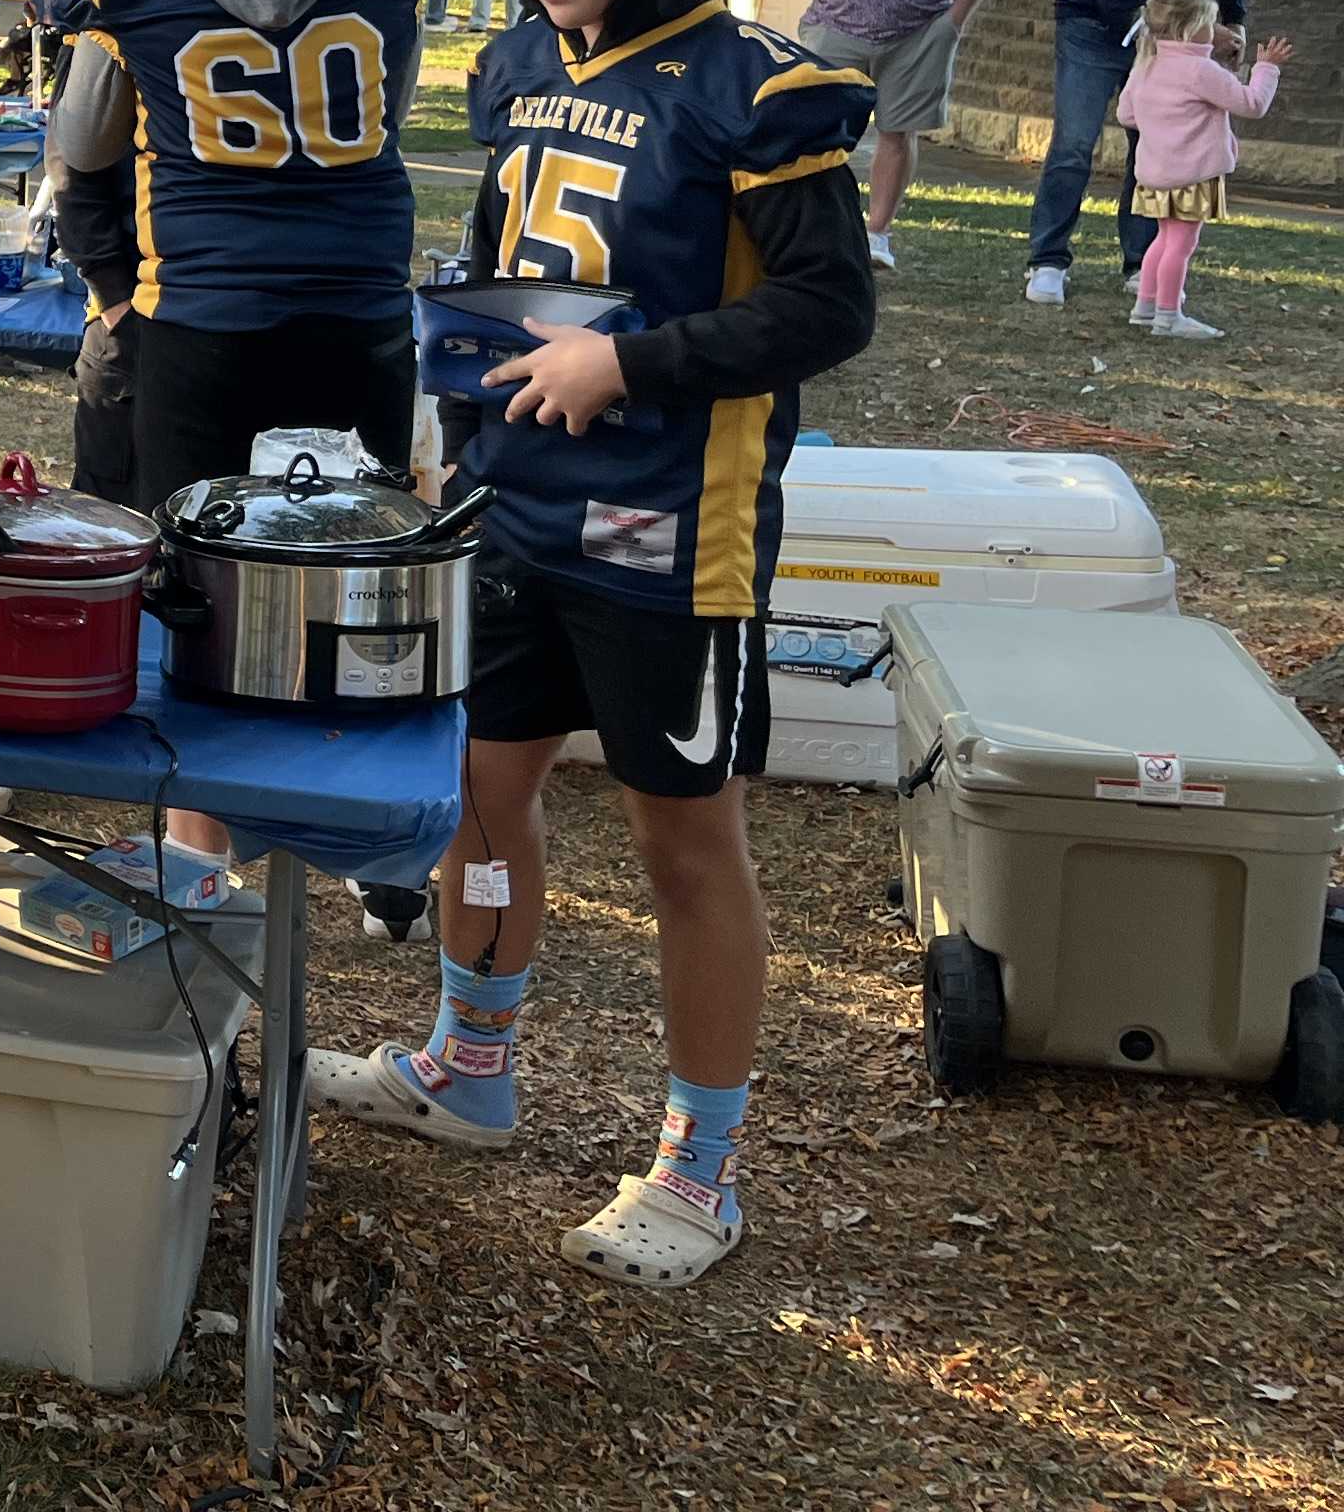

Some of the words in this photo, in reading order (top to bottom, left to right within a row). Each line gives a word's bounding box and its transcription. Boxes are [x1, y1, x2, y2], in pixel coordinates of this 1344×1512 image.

[174, 12, 388, 168] 60
[508, 95, 646, 148] BELLEVILLE
[495, 144, 627, 285] 15
[776, 567, 800, 579] LE
[807, 568, 855, 582] YOUTH
[863, 570, 939, 586] FOOTBALL
